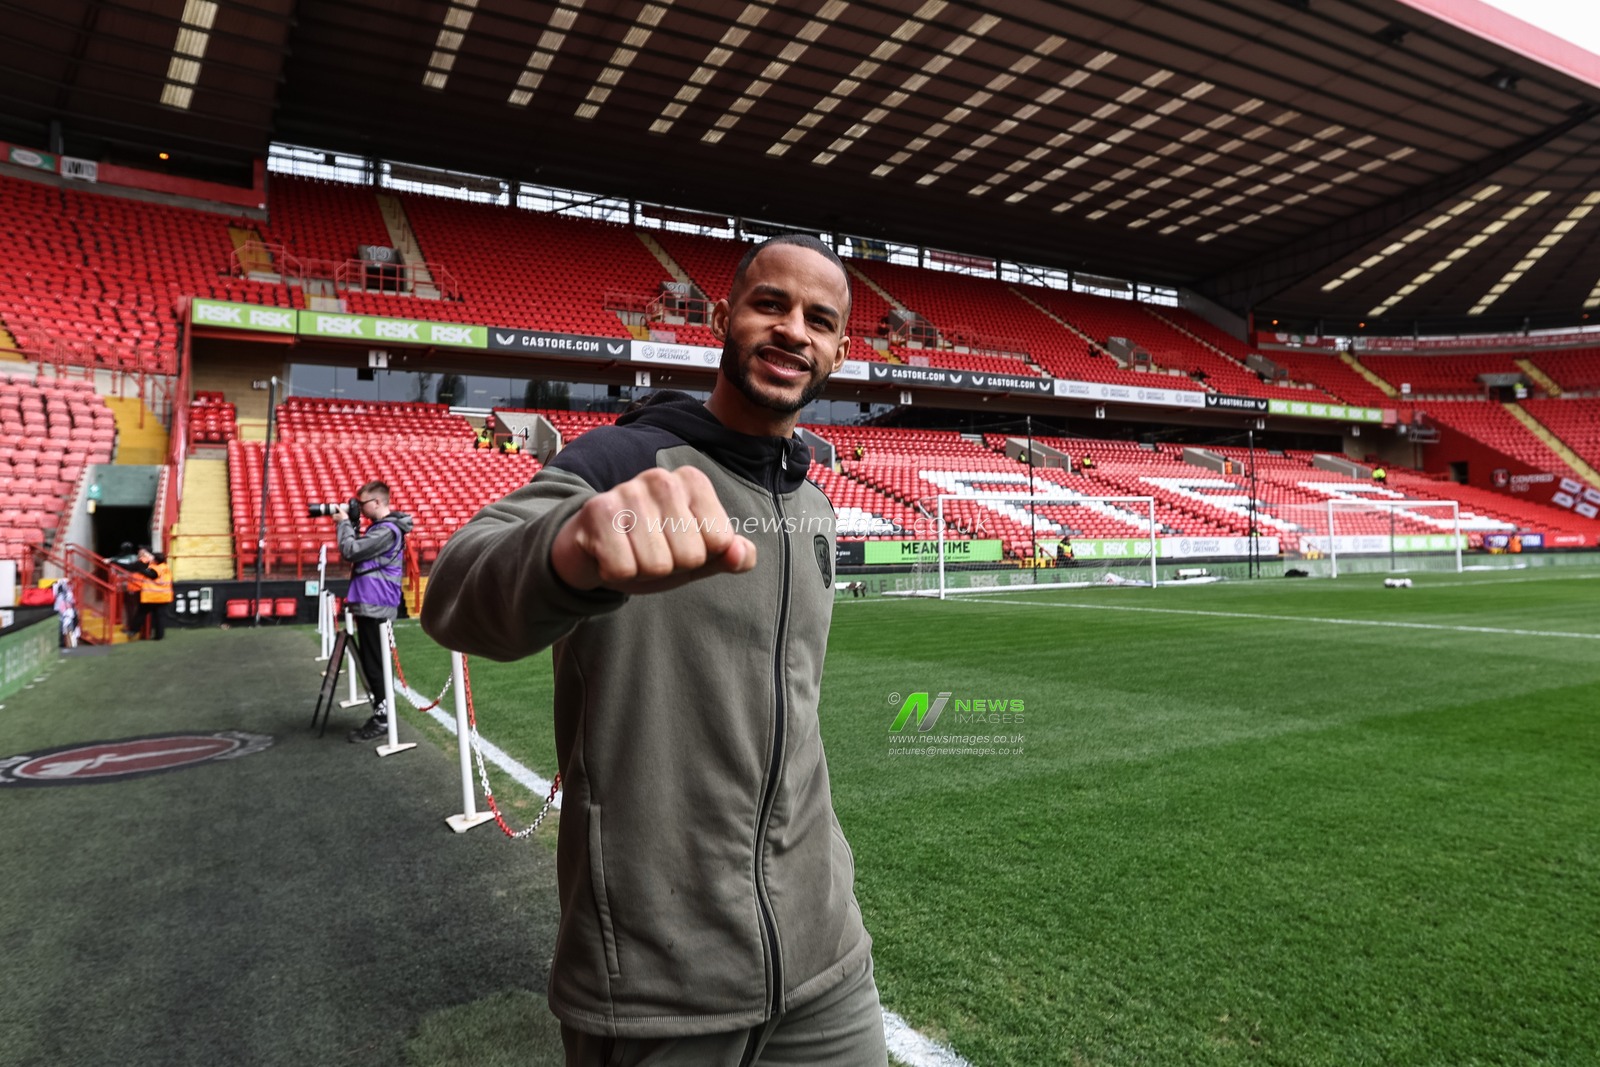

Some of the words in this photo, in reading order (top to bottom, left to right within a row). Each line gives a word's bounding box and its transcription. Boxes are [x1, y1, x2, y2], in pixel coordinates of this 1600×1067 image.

[367, 246, 391, 261] 19
[197, 304, 242, 324] RSK
[249, 309, 292, 329] RSK
[316, 315, 363, 335] RSK
[375, 320, 419, 340] RSK
[431, 325, 473, 344] RSK
[522, 336, 600, 352] CASTORE.COM
[891, 369, 945, 382] CASTORE.COM
[987, 377, 1036, 389] CASTORE.COM
[901, 541, 970, 554] MEANTIME
[1103, 541, 1127, 556] RSK
